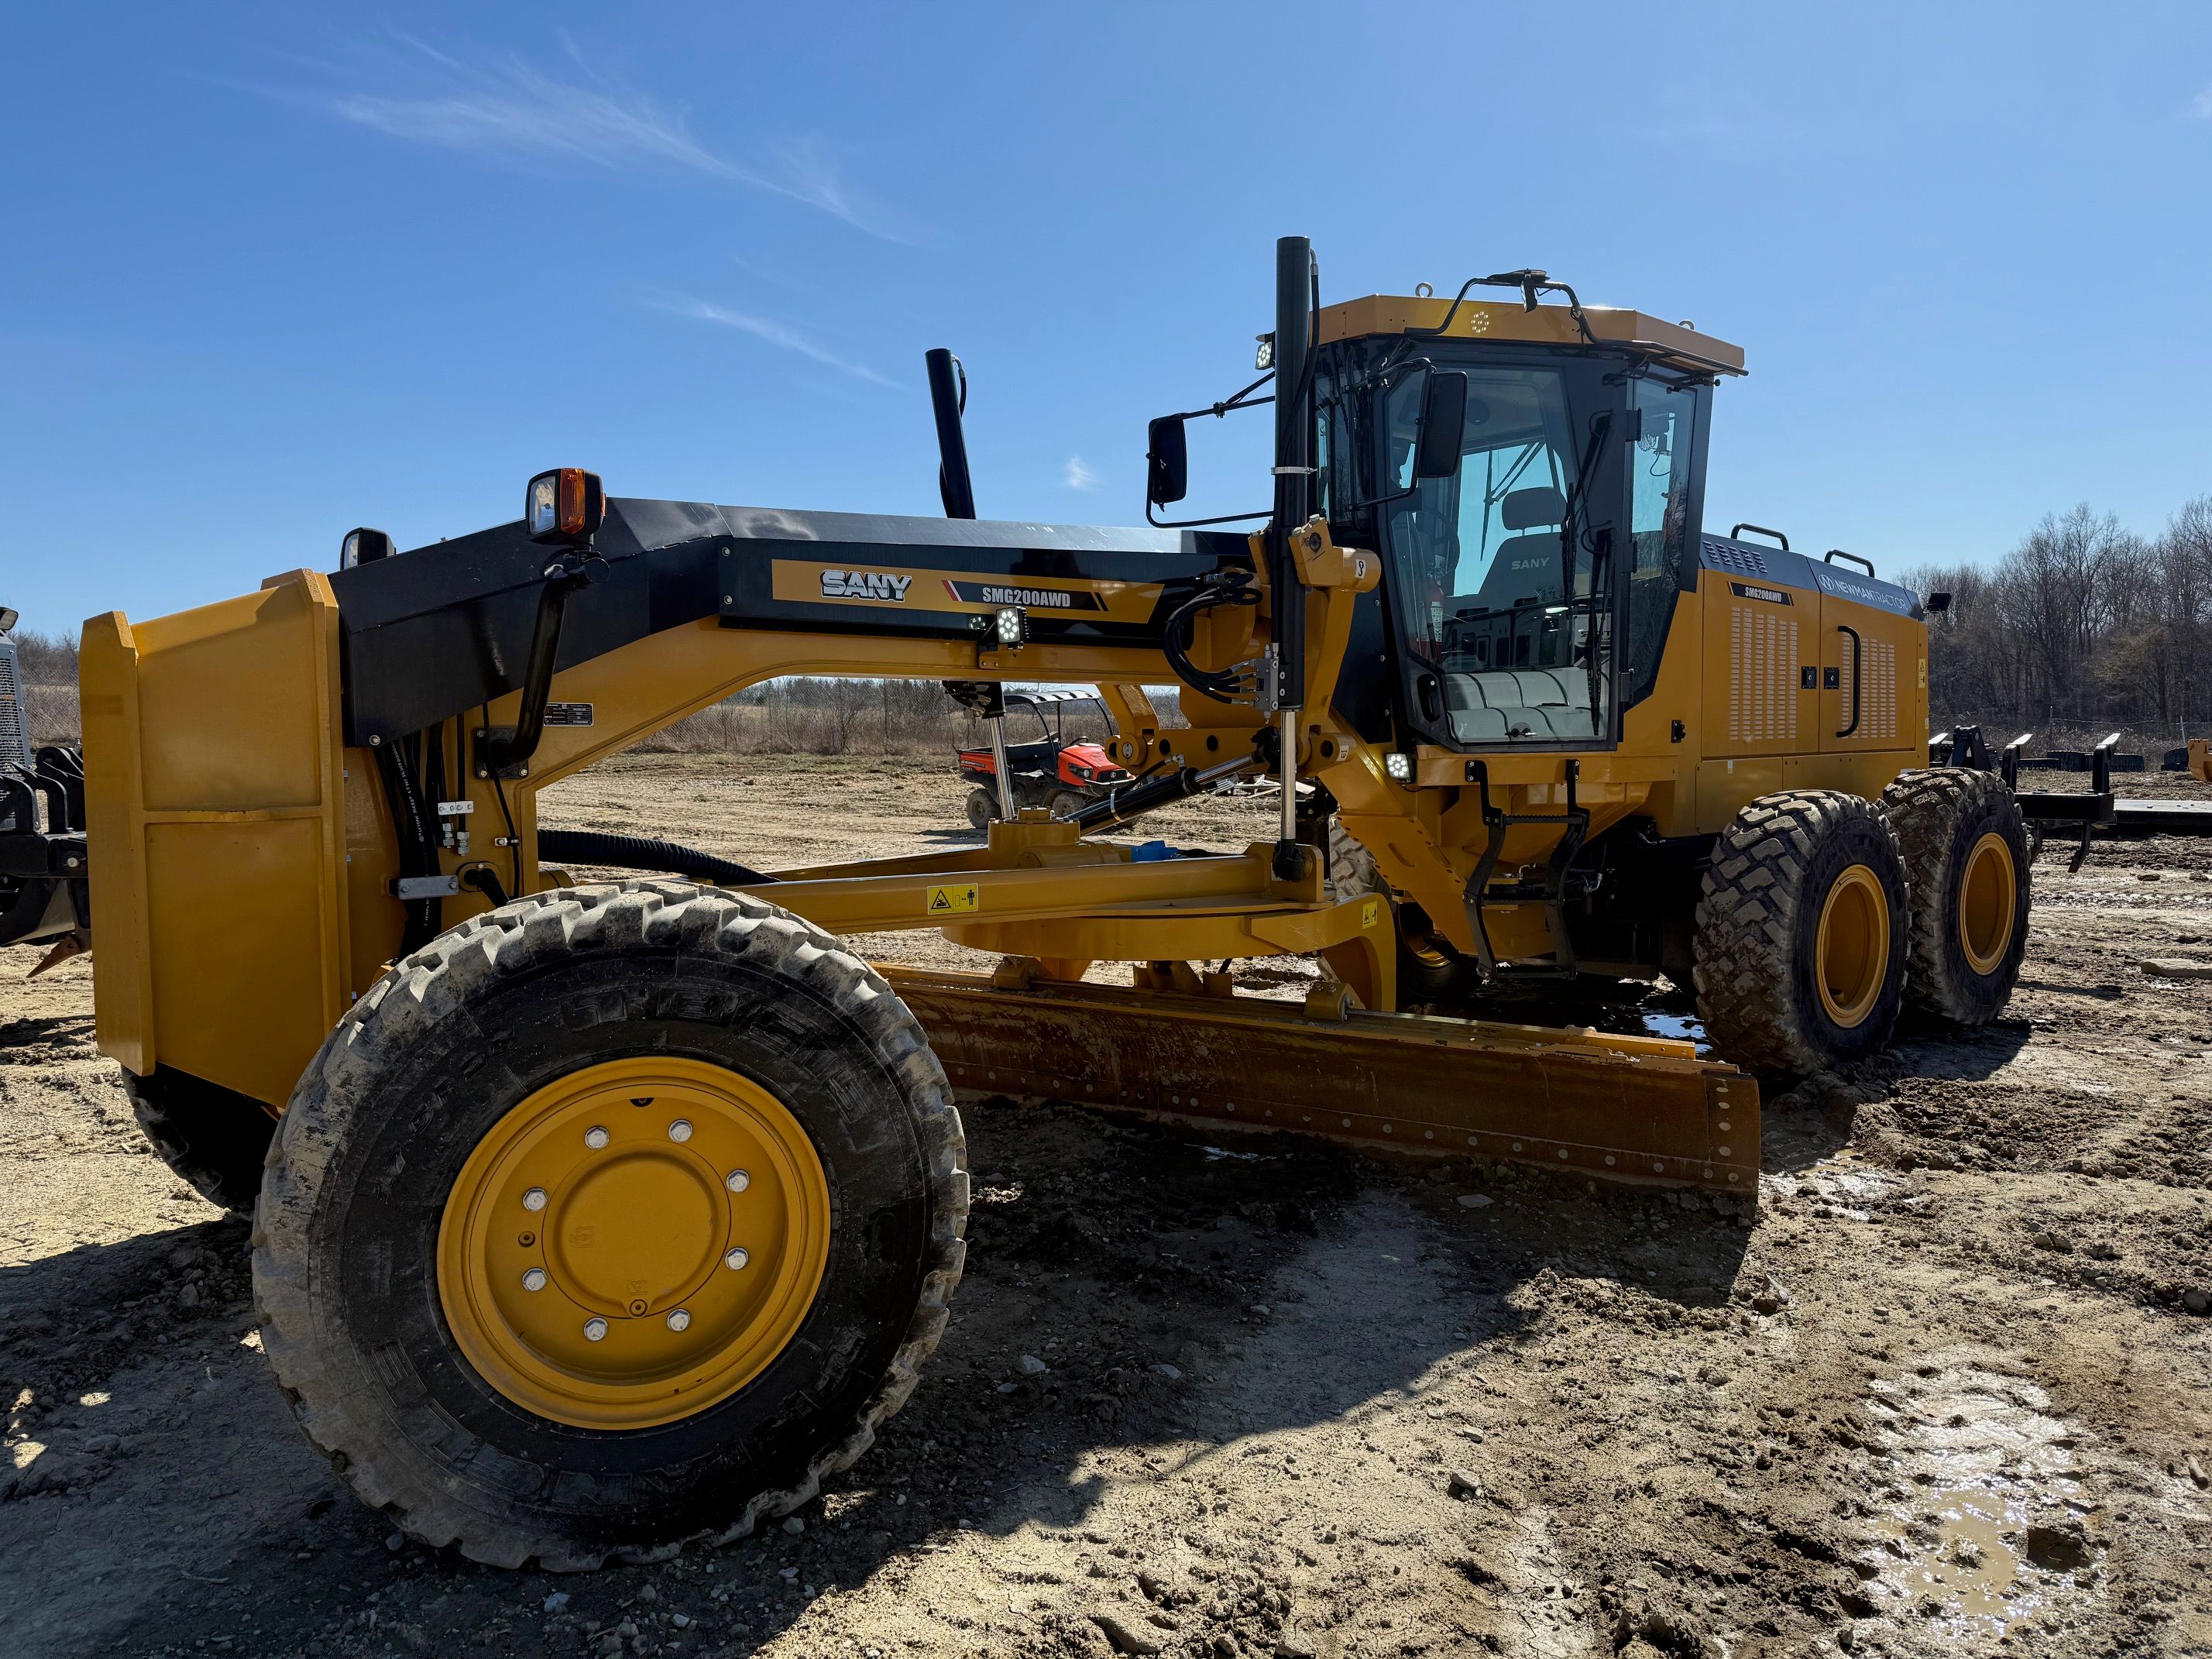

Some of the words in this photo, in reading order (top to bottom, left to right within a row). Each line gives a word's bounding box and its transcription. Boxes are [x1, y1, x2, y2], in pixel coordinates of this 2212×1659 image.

[1511, 557, 1550, 570] SANY
[820, 569, 912, 603] SANY
[1745, 586, 1782, 603] SMG200AWD
[982, 587, 1070, 607] SMG200AWD
